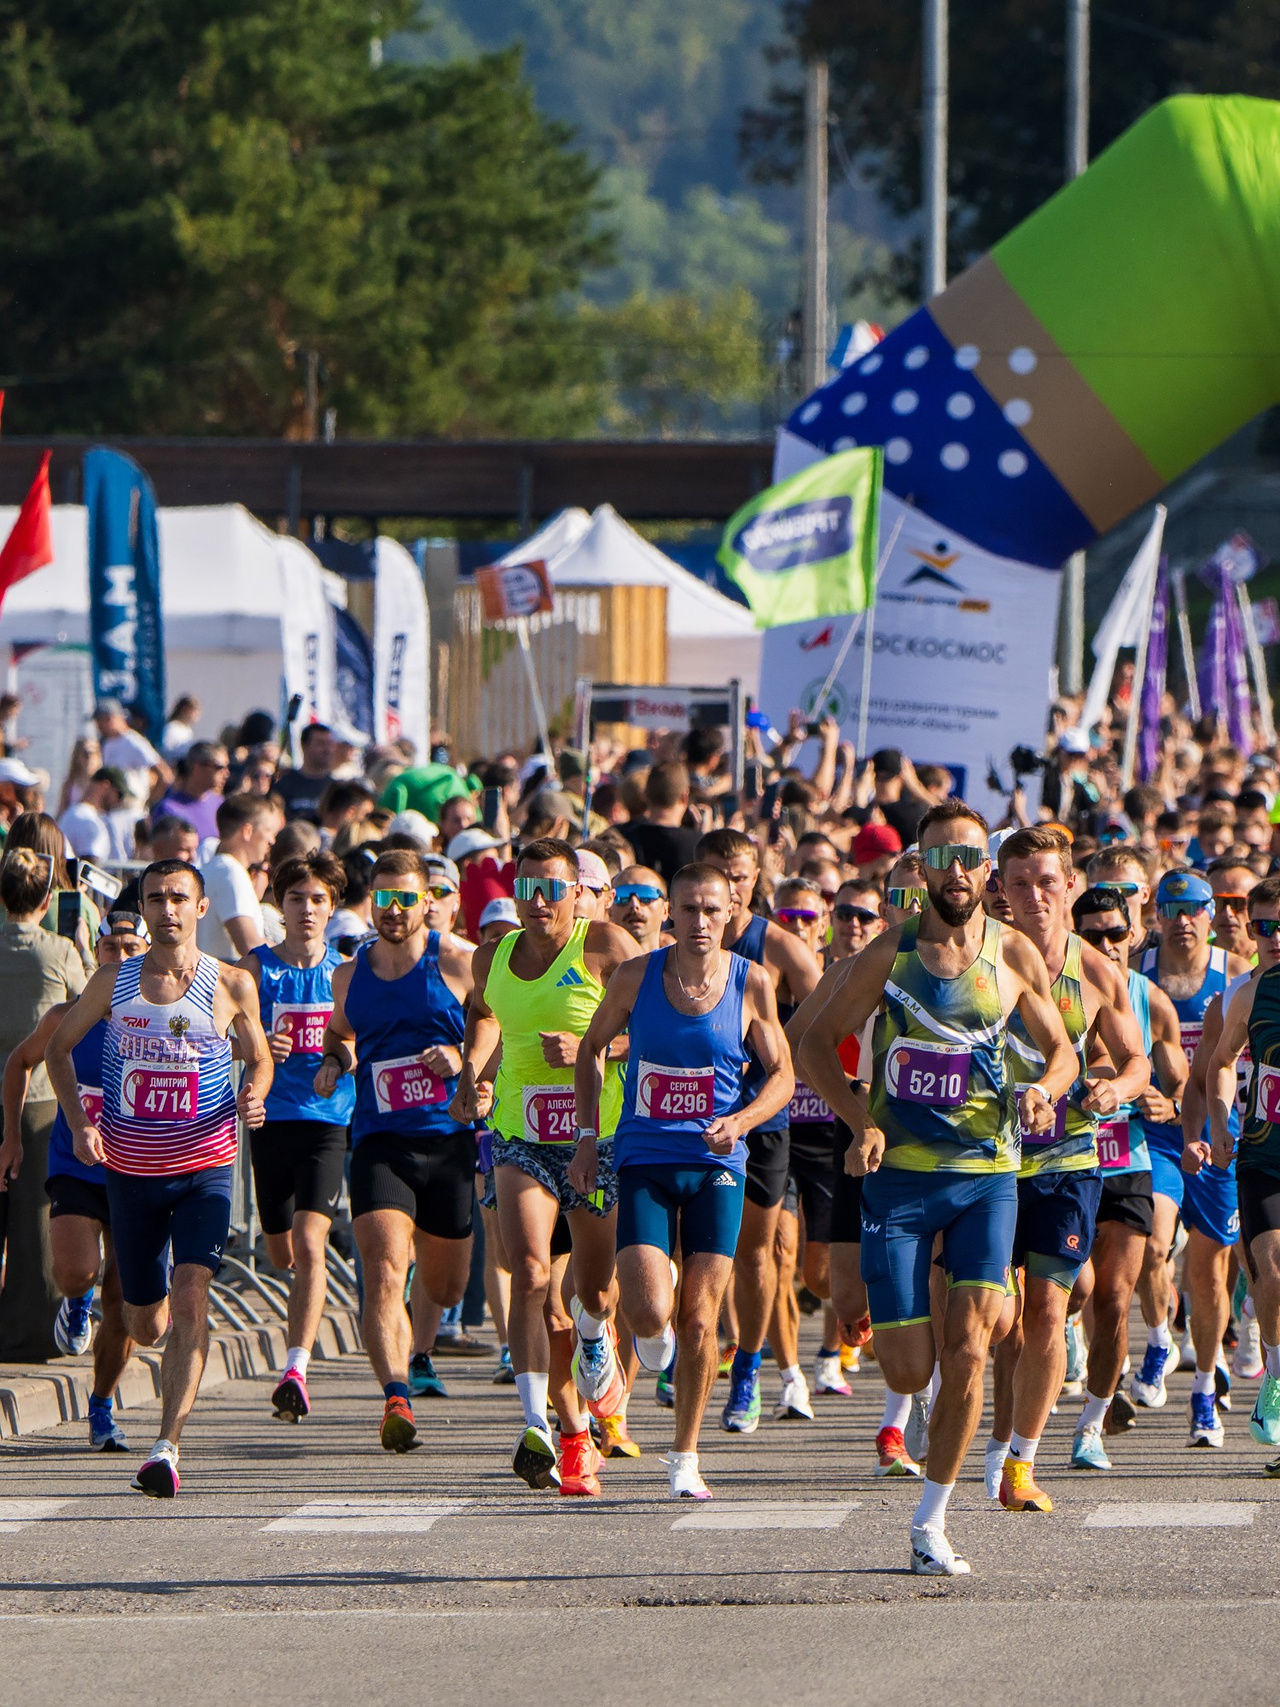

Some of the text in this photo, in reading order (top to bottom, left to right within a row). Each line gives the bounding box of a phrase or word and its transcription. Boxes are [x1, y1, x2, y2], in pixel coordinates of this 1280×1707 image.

[101, 564, 138, 699] J.A.M
[855, 631, 1008, 665] РОСКОСМОС
[894, 989, 921, 1014] J.A.M
[122, 1016, 151, 1029] RAY
[149, 1076, 188, 1088] ДМИТРИЙ
[403, 1068, 424, 1080] ИВАН
[909, 1069, 961, 1099] 5210
[401, 1078, 435, 1104] 392
[669, 1081, 699, 1092] СЕРГЕЙ
[144, 1090, 192, 1113] 4714
[660, 1092, 707, 1114] 4296
[790, 1098, 829, 1118] 3420
[713, 1179, 738, 1187] adidas
